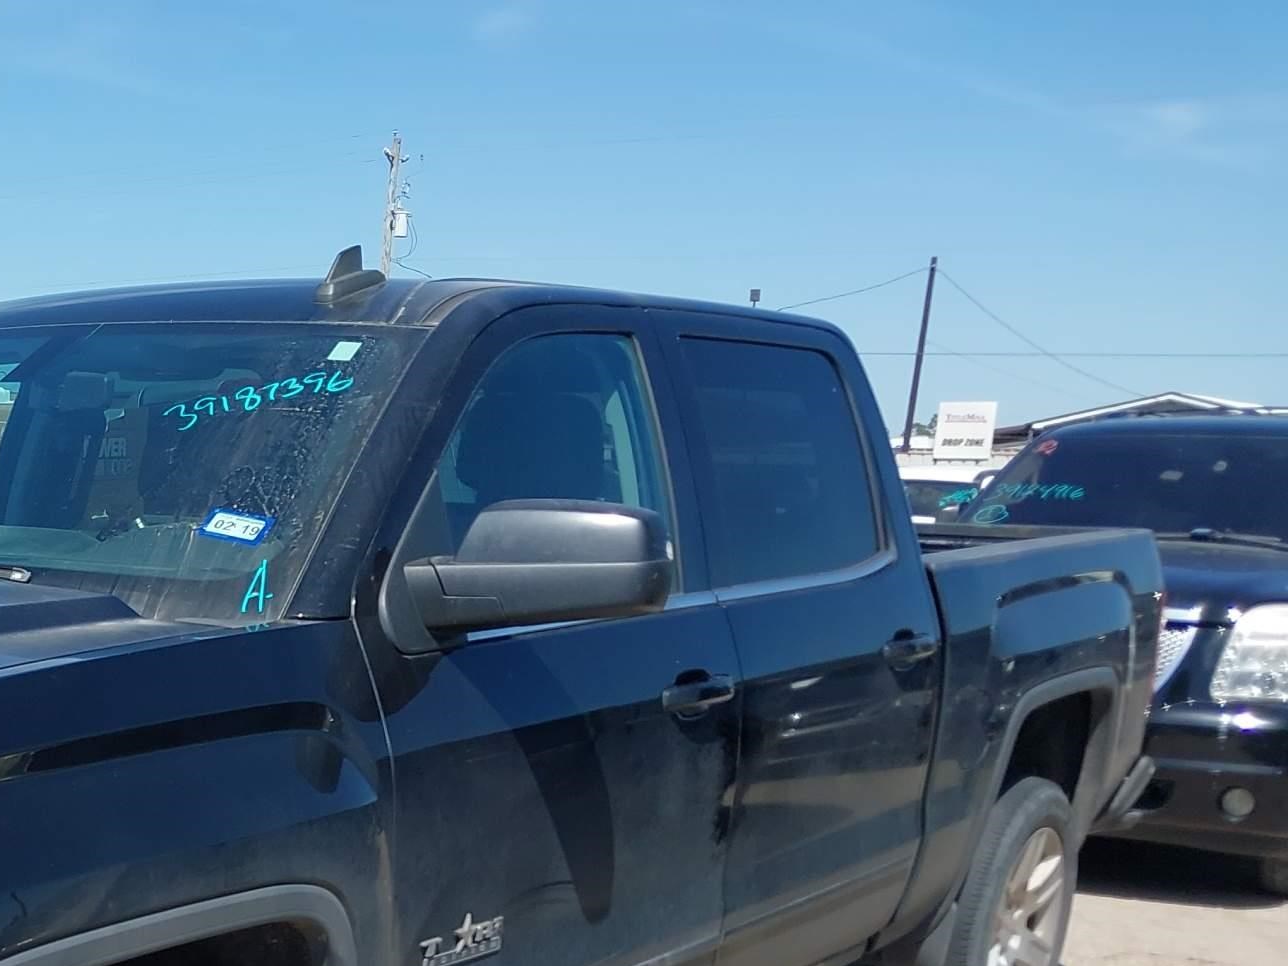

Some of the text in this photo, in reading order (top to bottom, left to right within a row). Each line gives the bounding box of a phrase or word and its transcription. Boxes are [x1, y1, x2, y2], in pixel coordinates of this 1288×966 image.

[162, 370, 354, 431] 39187396
[214, 519, 234, 531] 02
[242, 524, 260, 536] 19
